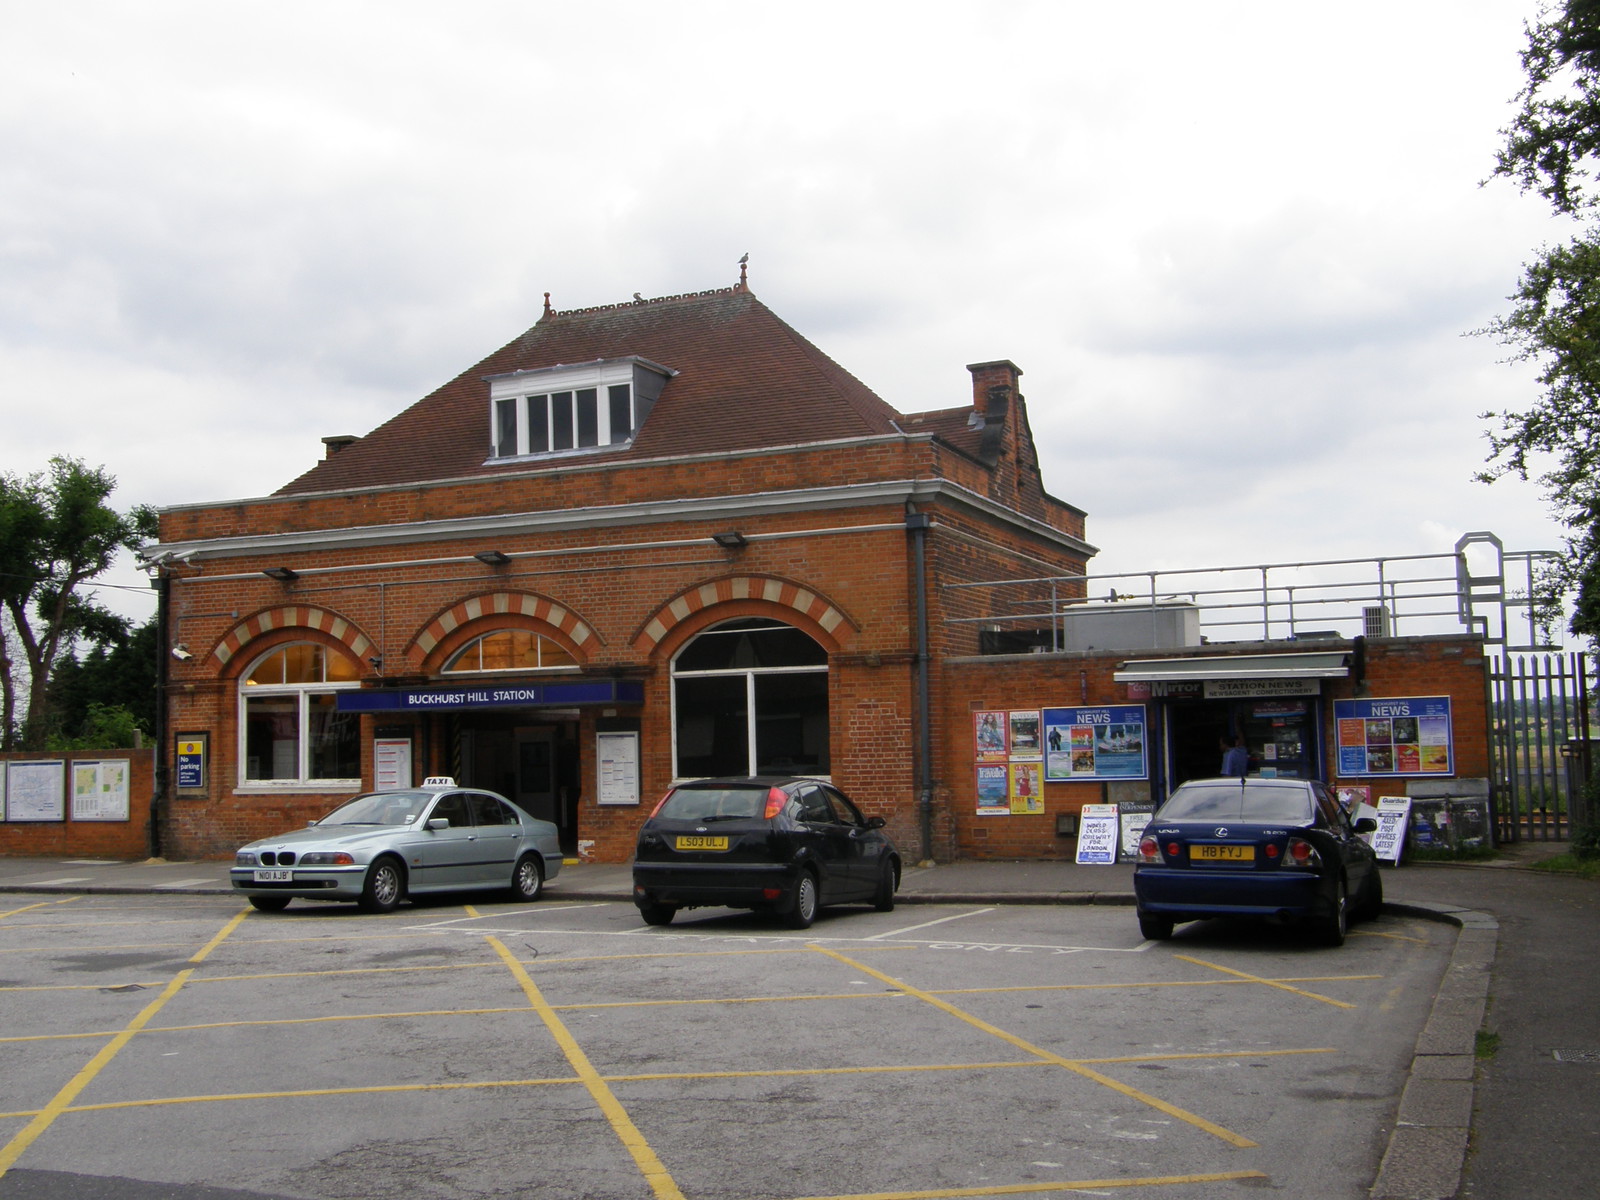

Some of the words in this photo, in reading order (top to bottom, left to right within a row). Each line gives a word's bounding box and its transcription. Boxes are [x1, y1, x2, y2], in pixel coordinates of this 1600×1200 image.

[1152, 681, 1200, 697] Mirror
[1218, 682, 1265, 690] STATION
[1268, 680, 1303, 689] NEWS
[408, 693, 465, 705] BUCKHURST
[467, 692, 489, 702] HILL
[493, 690, 535, 701] STATION
[1209, 689, 1251, 697] NEWSAGENT
[1255, 687, 1313, 696] CONFECTIONERY
[1371, 705, 1410, 716] NEWS
[1076, 713, 1111, 724] NEWS
[180, 763, 200, 771] parking
[680, 837, 704, 847] LS03
[706, 837, 725, 847] ULJ
[1220, 846, 1242, 858] FYJ
[273, 871, 287, 880] AJB
[928, 943, 1084, 955] ONLY
